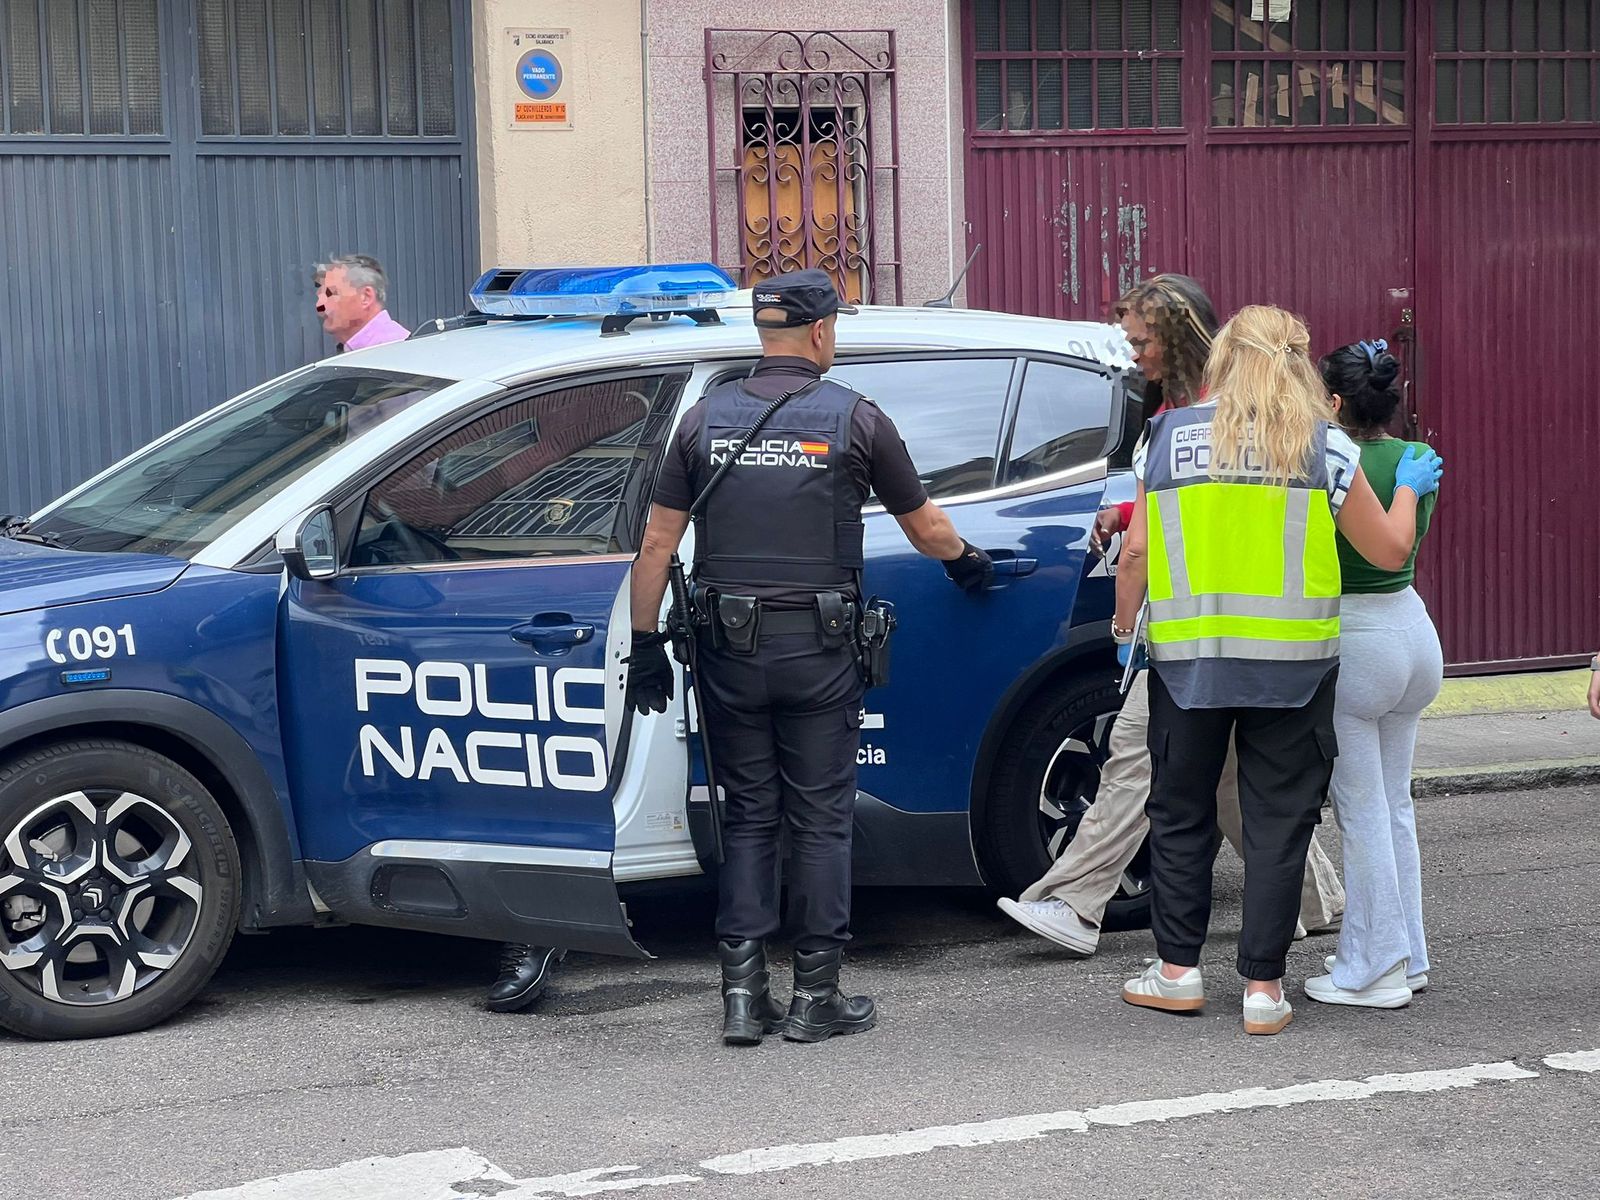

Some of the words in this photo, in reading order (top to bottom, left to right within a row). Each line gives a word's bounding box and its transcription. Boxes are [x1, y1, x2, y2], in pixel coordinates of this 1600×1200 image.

[710, 453, 828, 468] NCIONAL
[1176, 428, 1212, 443] CUERP
[69, 624, 136, 661] 091
[355, 658, 605, 724] POLIC
[359, 724, 608, 792] NACIO
[180, 793, 230, 876] MICHELIN
